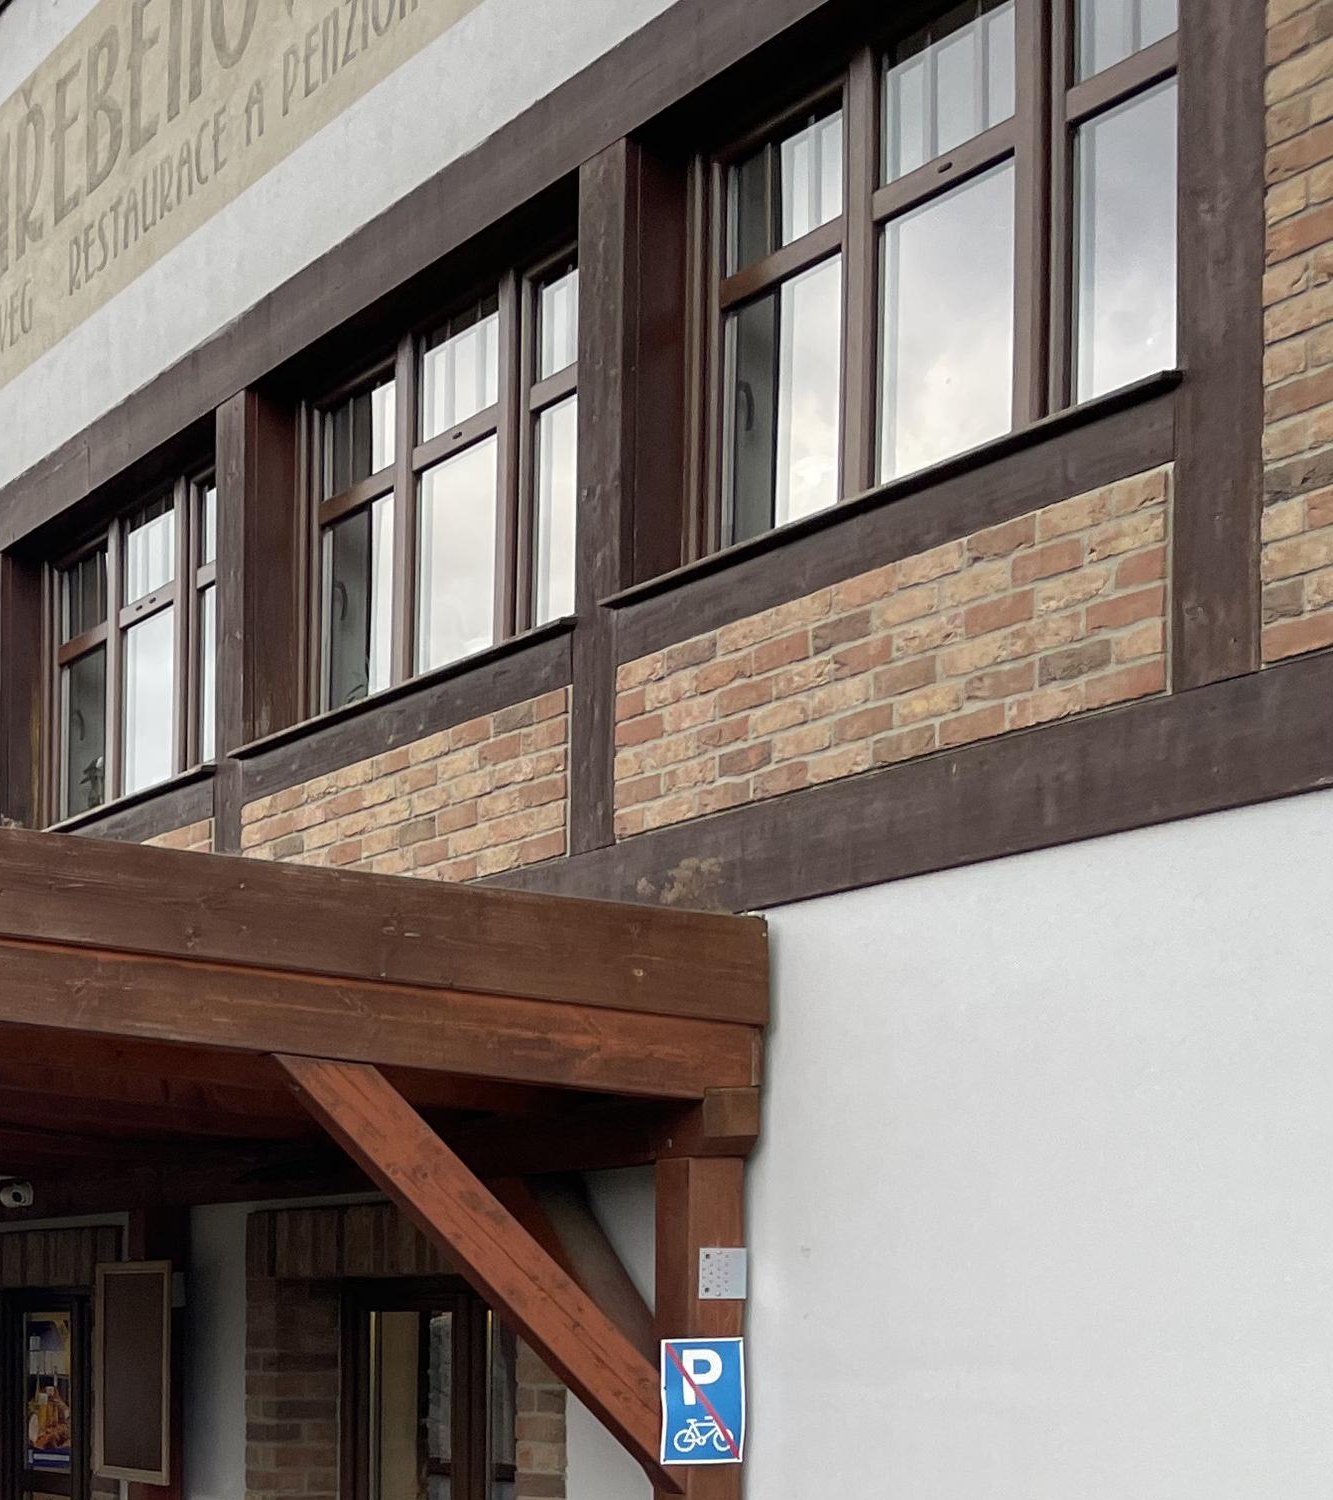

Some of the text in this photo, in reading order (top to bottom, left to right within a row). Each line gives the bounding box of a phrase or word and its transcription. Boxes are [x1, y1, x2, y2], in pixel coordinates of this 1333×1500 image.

[67, 0, 419, 297] RESTAURACE A PENZIO
[681, 1348, 723, 1406] P
